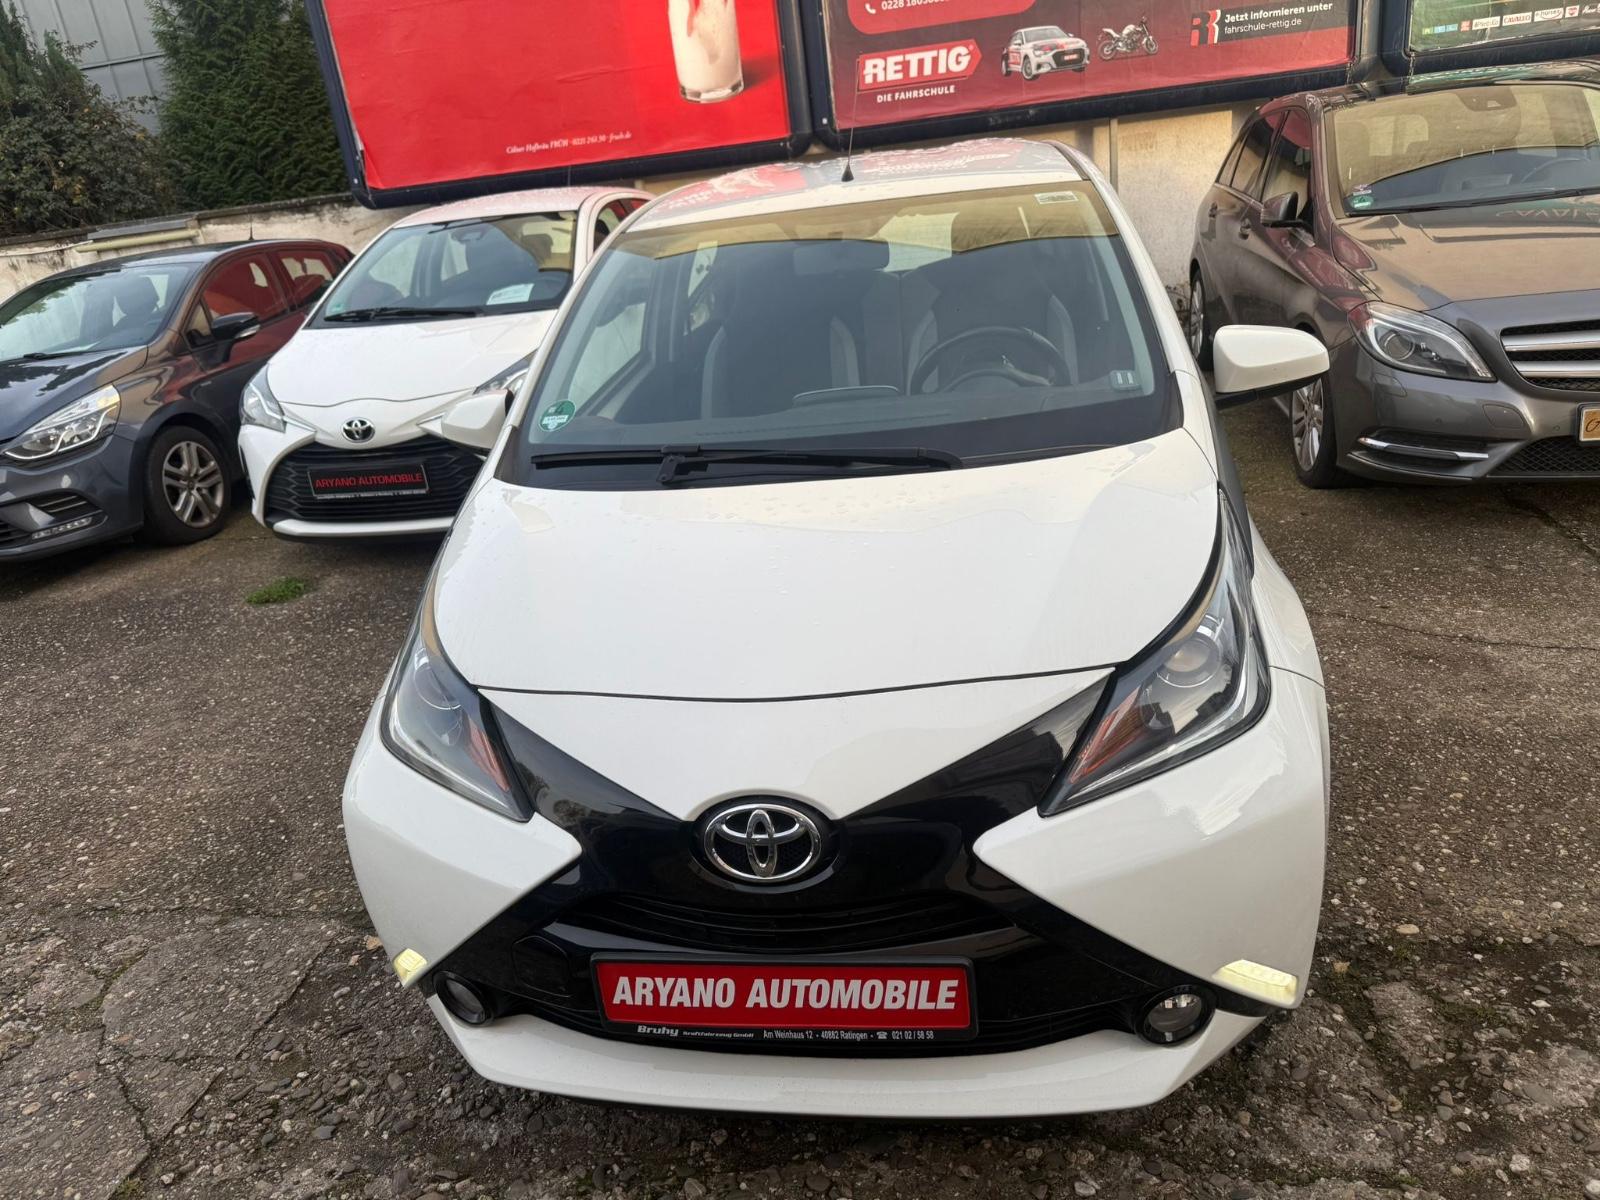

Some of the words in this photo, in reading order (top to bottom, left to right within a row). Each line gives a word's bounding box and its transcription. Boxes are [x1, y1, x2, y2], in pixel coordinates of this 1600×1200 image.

[1224, 12, 1248, 23] Jetzt
[1250, 7, 1305, 20] informieren
[1307, 2, 1333, 13] unter
[1224, 17, 1302, 34] fahrschule-rettig.de
[863, 45, 971, 84] RETTIG
[877, 93, 892, 103] DIE
[895, 85, 955, 101] FAHRSCHULE
[315, 476, 357, 488] ARYANO
[358, 472, 422, 485] AUTOMOBILE
[612, 975, 736, 1009] ARYANO
[745, 978, 959, 1010] AUTOMOBILE
[637, 1024, 679, 1037] Bruhy
[763, 1030, 774, 1039] Am
[774, 1030, 805, 1039] Weinhaus
[806, 1030, 813, 1039] 12
[840, 1030, 868, 1042] Ratingen
[926, 1030, 934, 1040] 58
